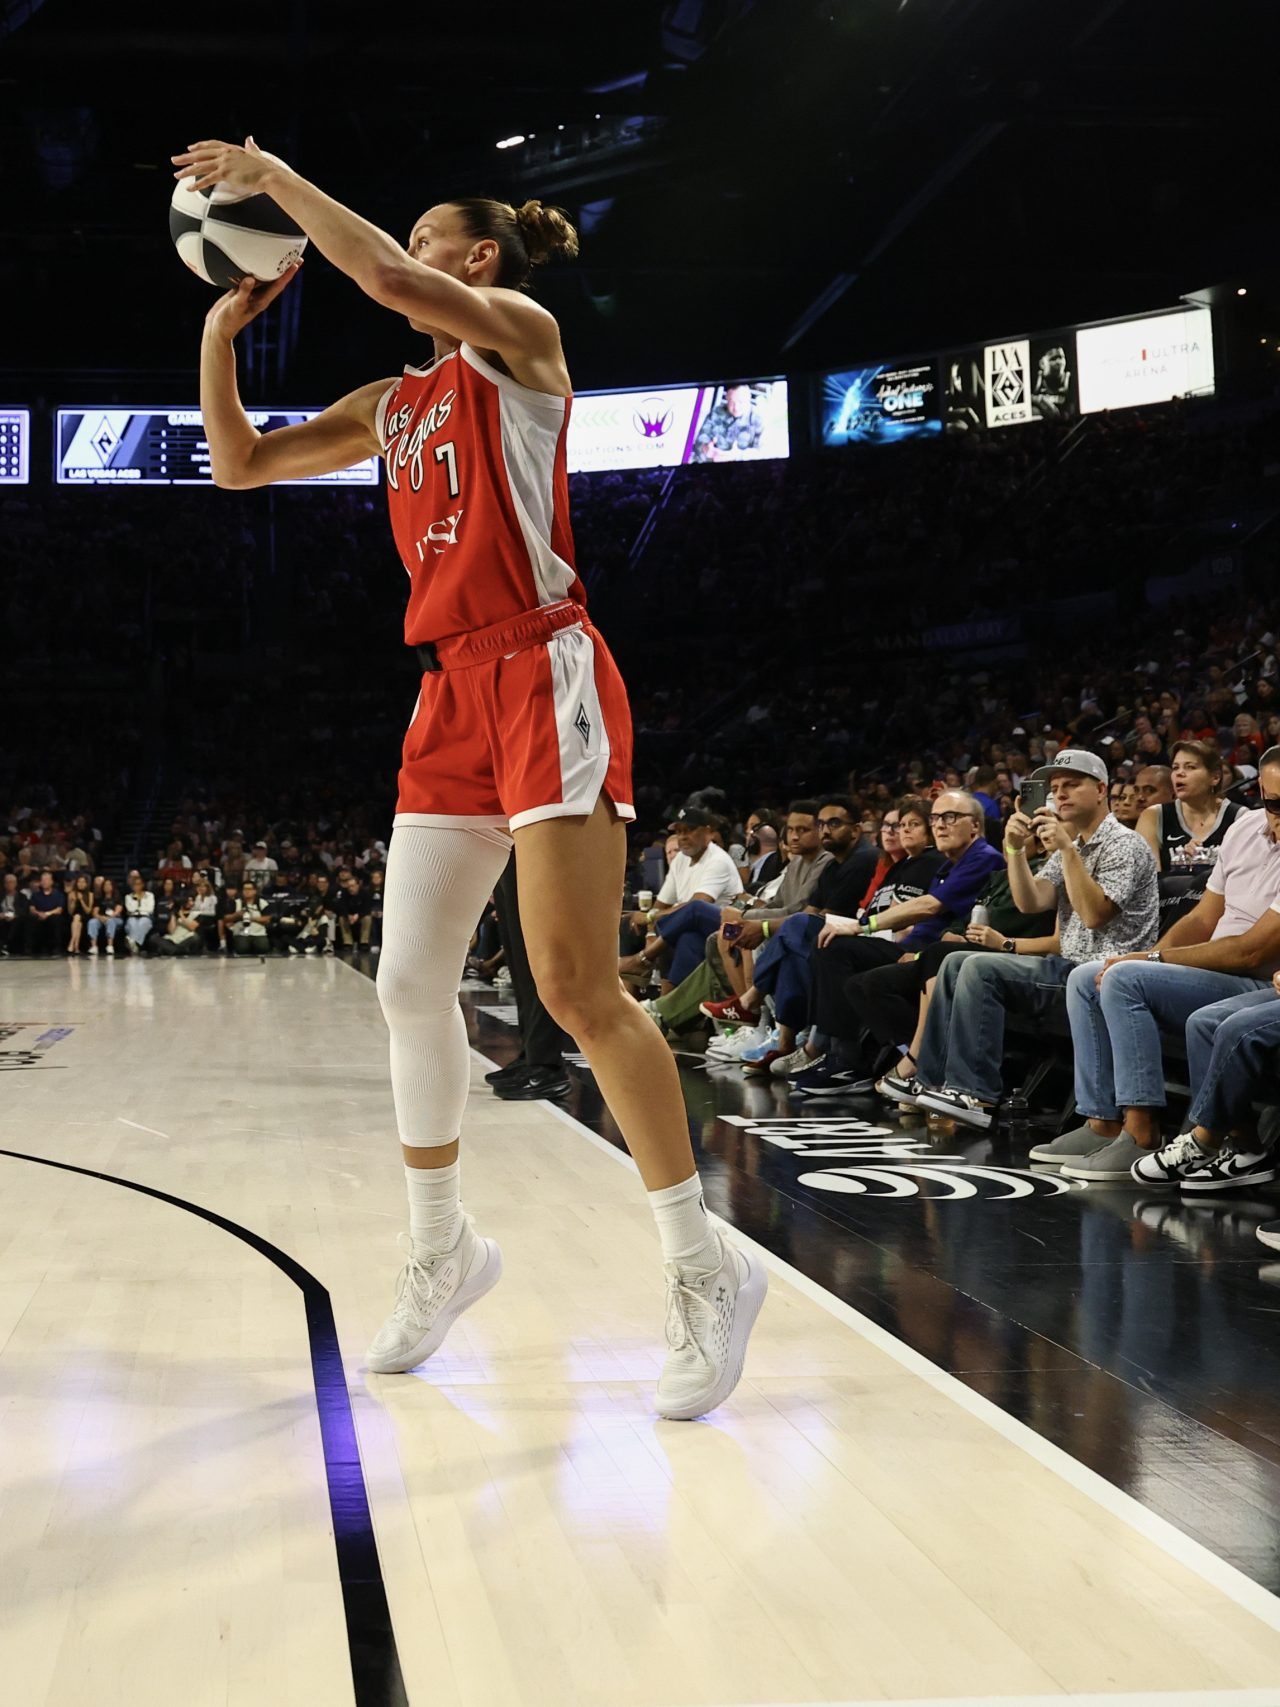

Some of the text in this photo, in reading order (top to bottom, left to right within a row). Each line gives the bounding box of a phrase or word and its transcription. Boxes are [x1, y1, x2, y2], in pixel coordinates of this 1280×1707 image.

[883, 391, 924, 411] ONE
[994, 410, 1026, 422] ACES
[435, 441, 459, 496] 7
